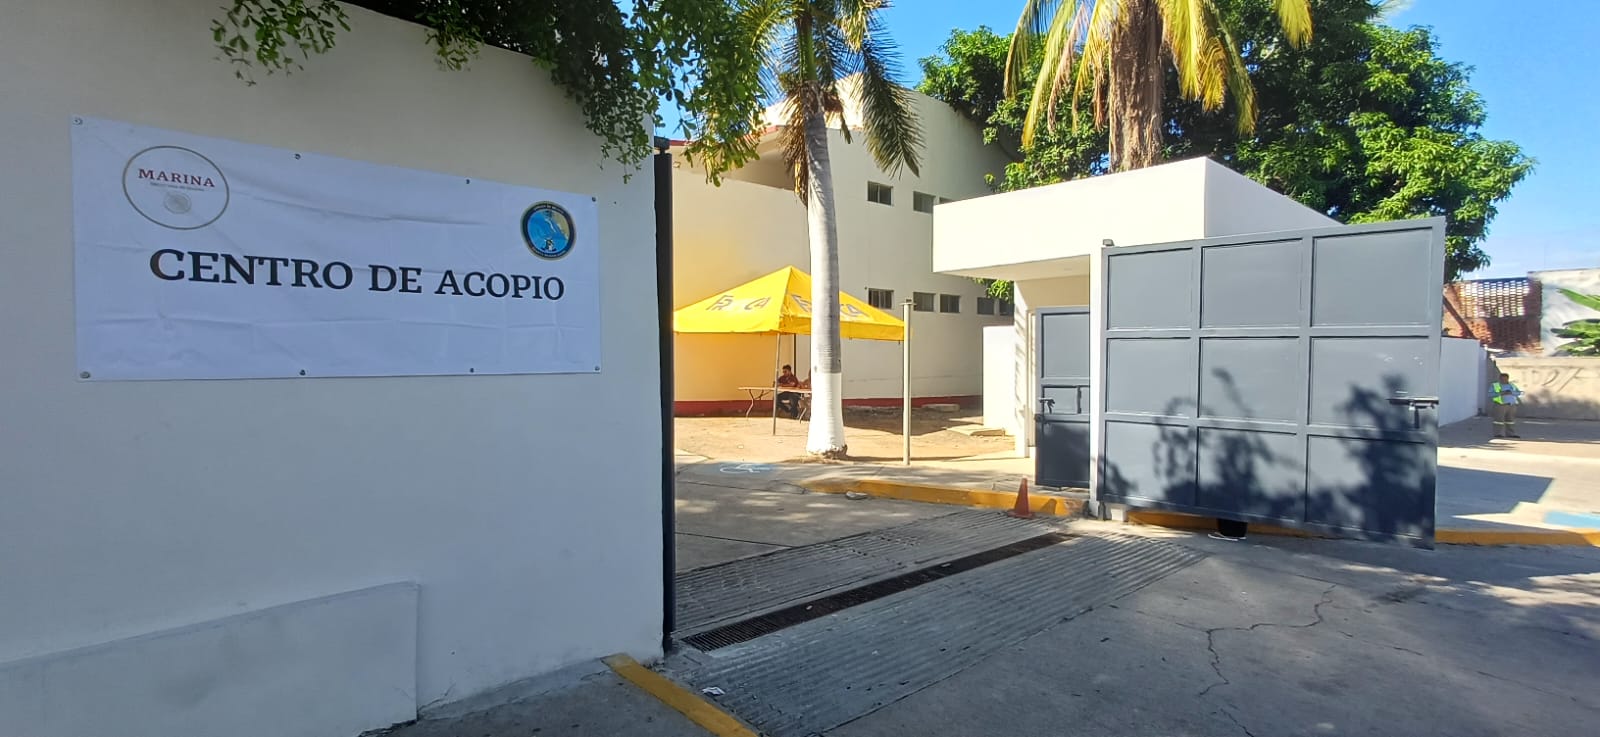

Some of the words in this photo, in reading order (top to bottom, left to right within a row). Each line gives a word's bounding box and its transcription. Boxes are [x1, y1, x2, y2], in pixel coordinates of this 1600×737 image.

[138, 168, 215, 188] MARINA
[149, 248, 353, 290] CENTRO
[368, 264, 422, 294] DE
[434, 269, 565, 301] ACOPIO
